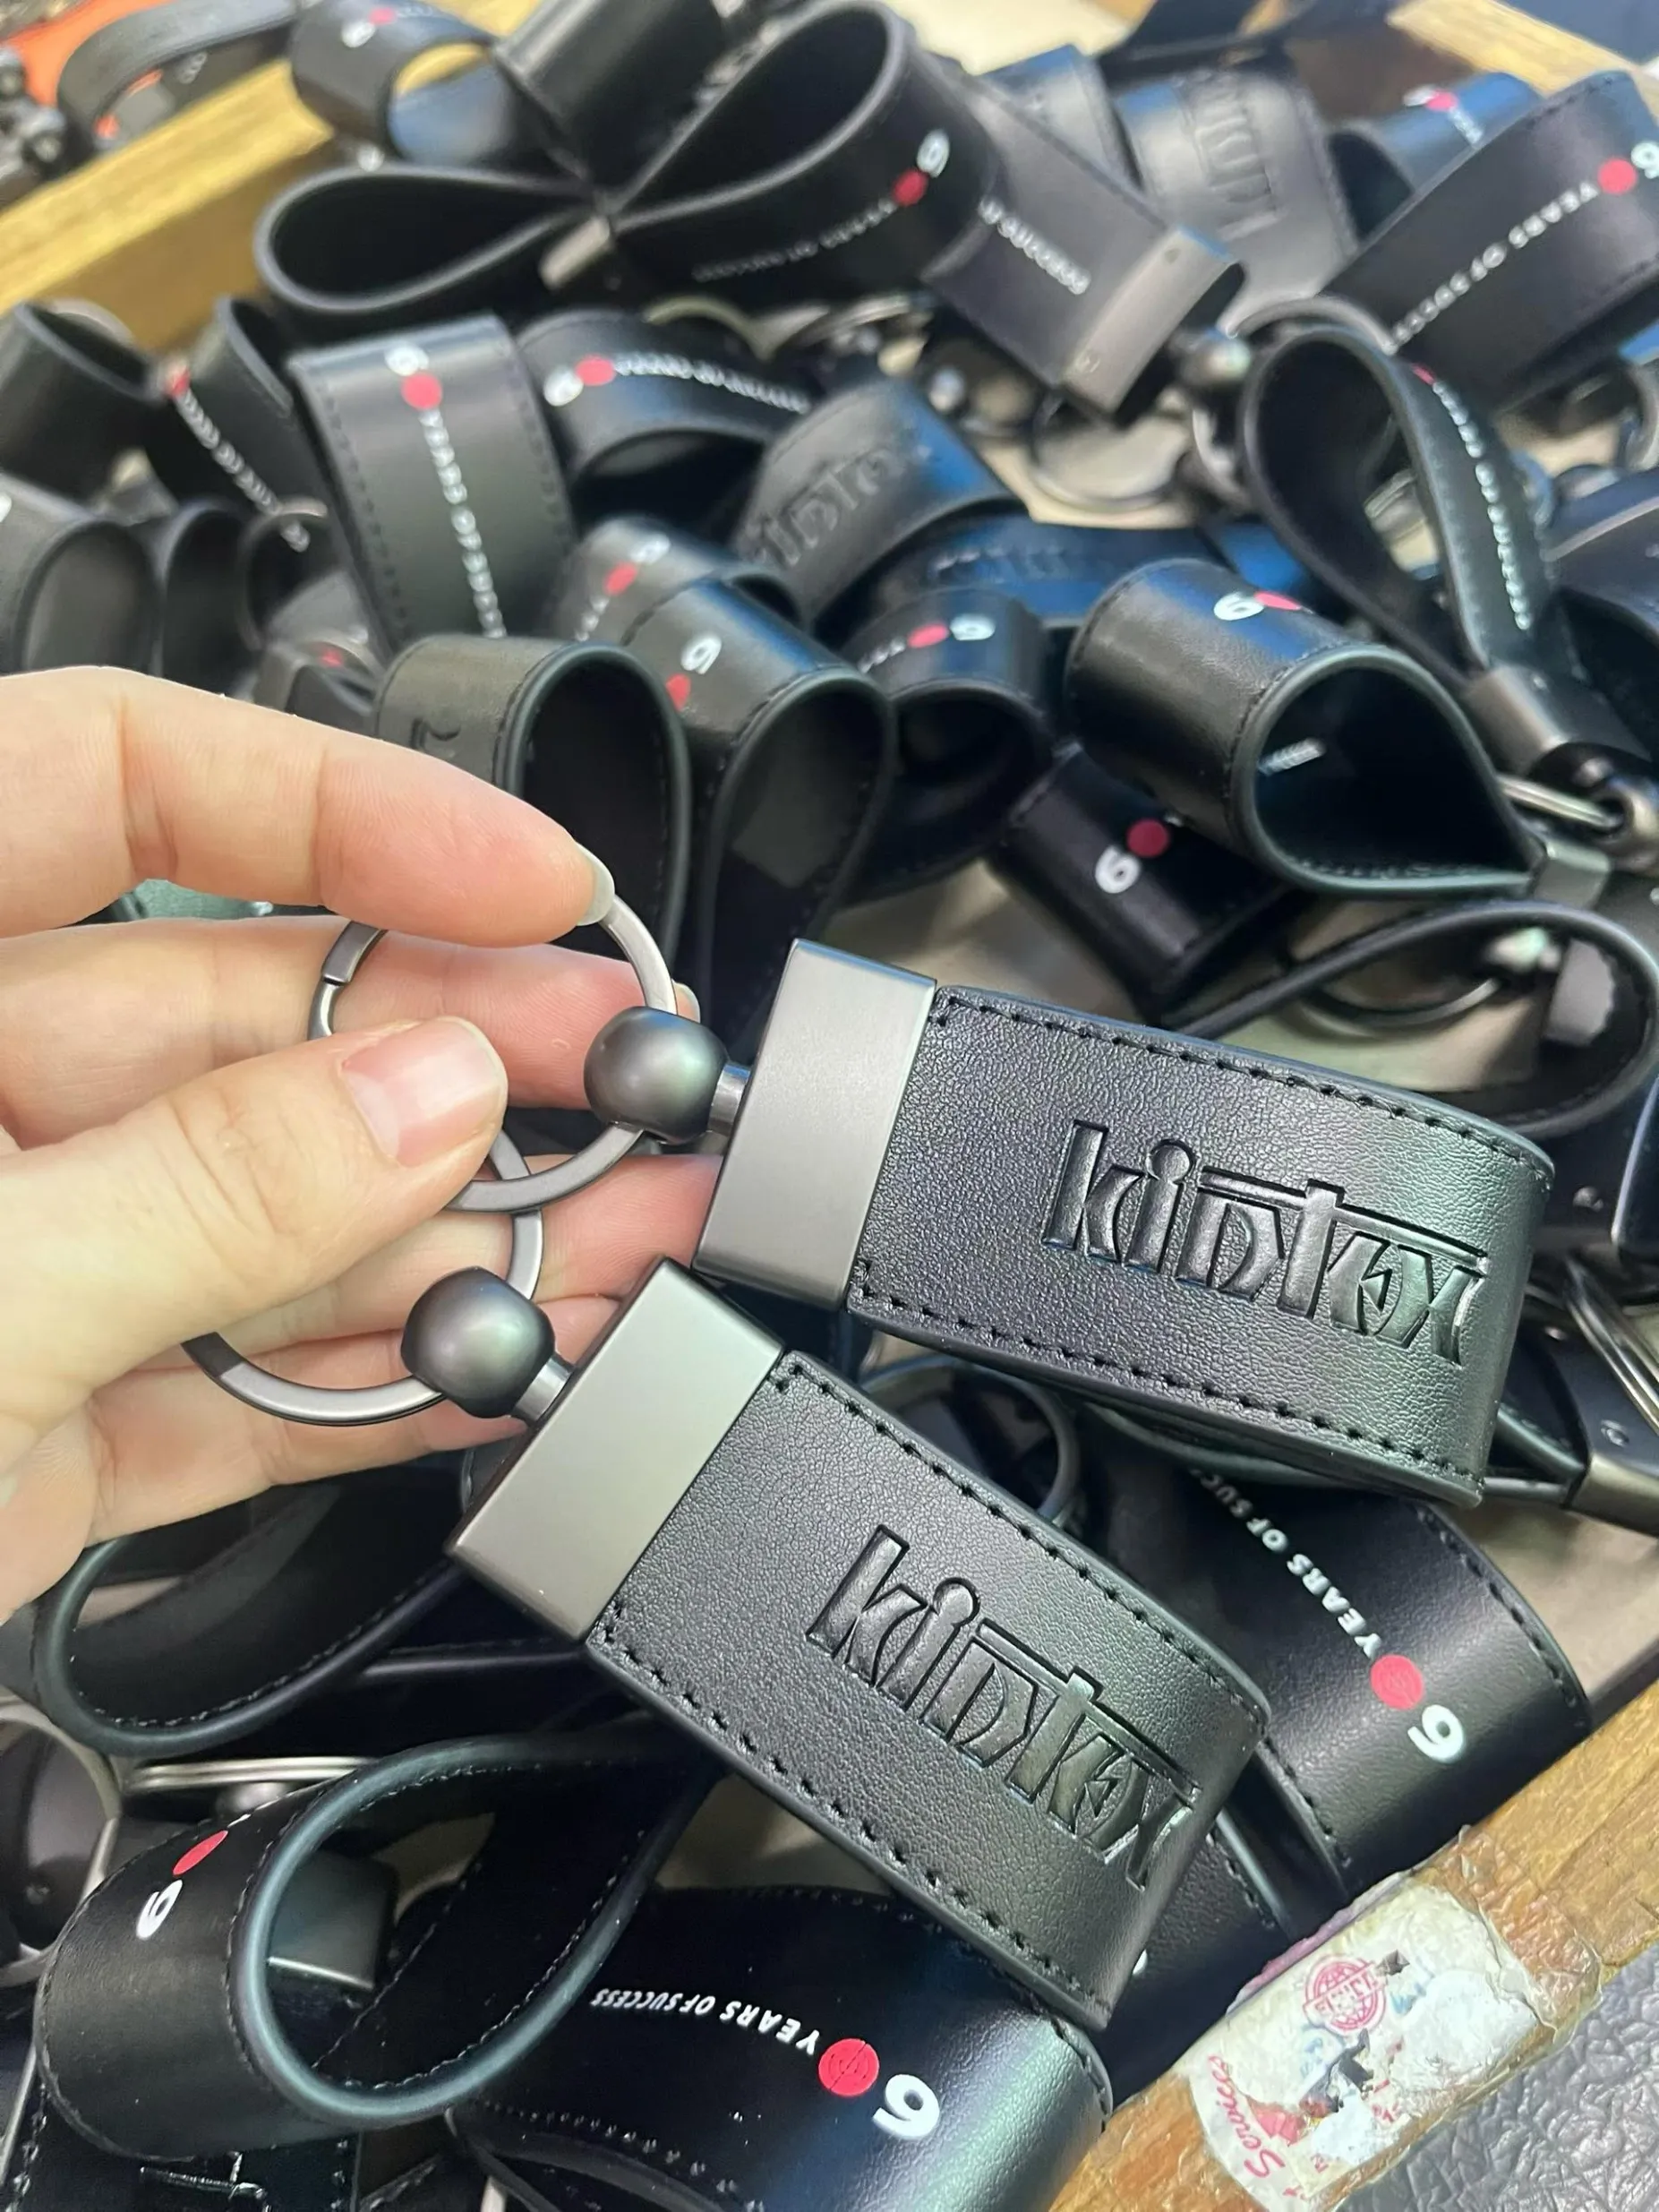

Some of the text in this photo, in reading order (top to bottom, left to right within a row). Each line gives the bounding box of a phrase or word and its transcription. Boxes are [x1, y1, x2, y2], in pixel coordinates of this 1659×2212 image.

[1246, 1516, 1287, 1552] OF
[1287, 1553, 1381, 1658] YEARS
[589, 1987, 684, 2011] SUCCESS
[679, 1993, 716, 2016] OF
[719, 2001, 820, 2056] YEARS
